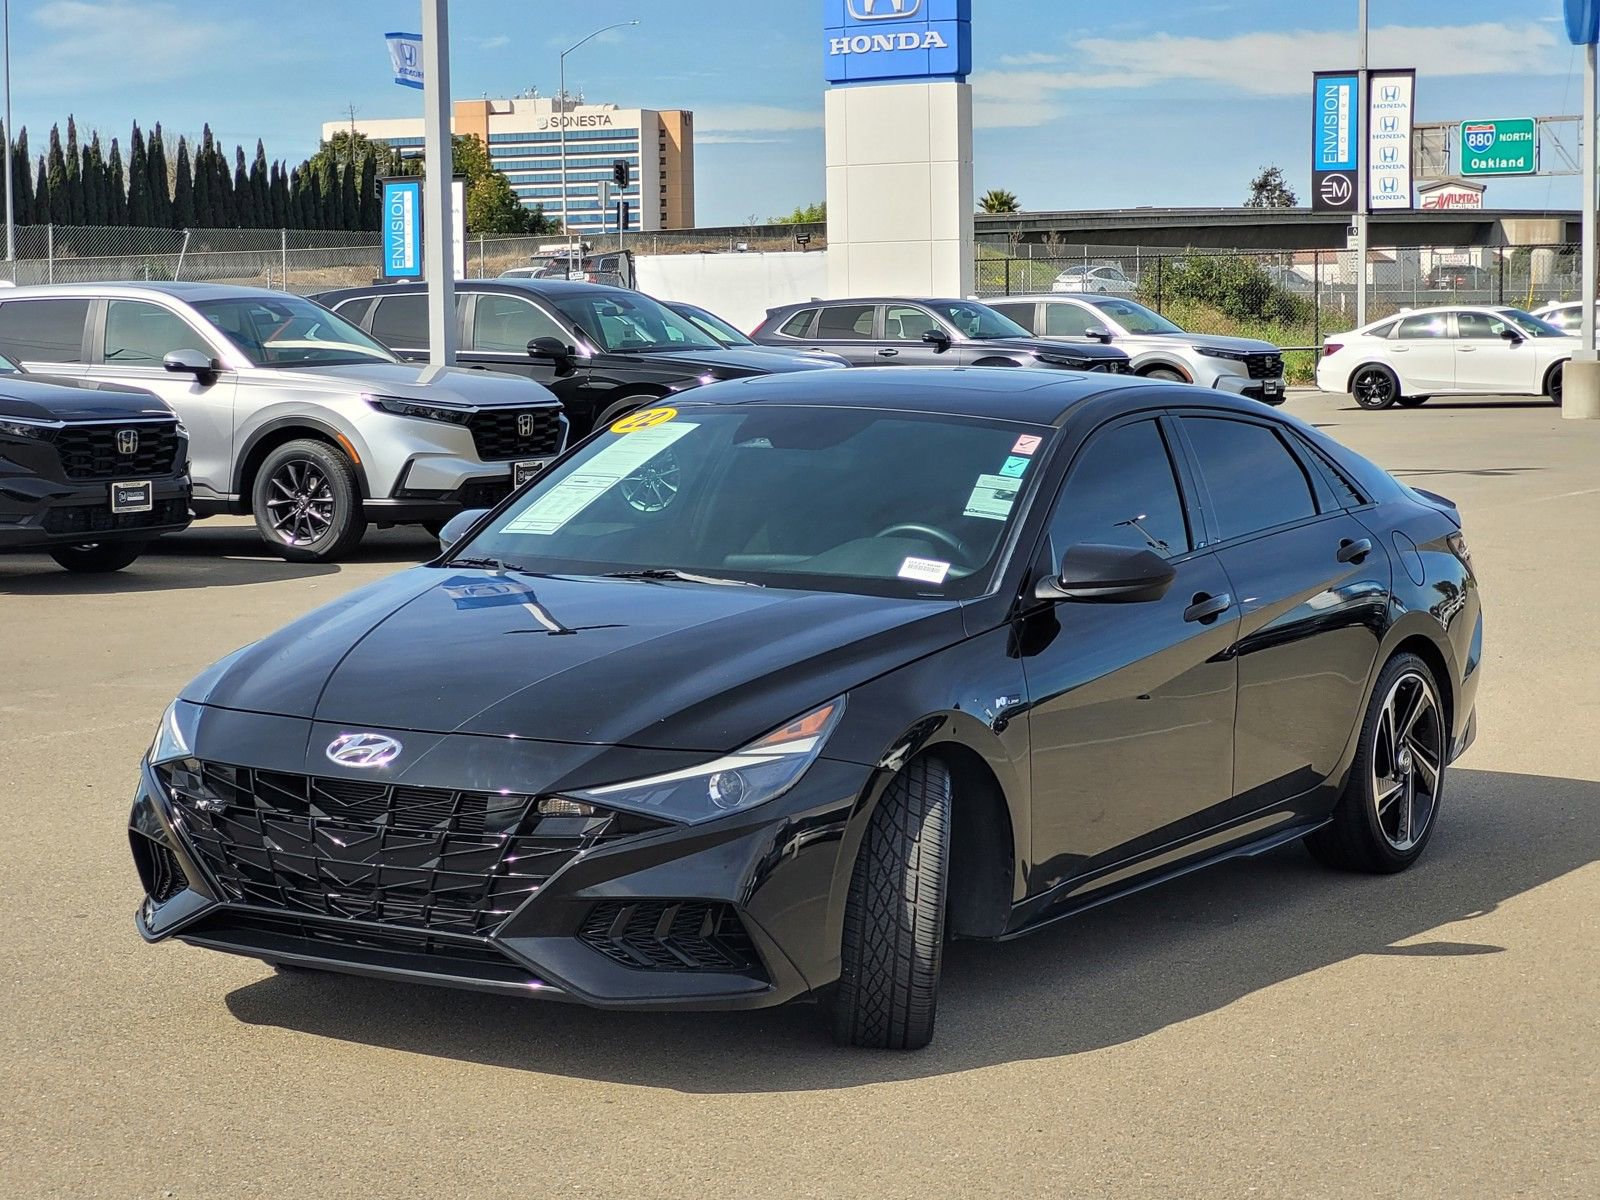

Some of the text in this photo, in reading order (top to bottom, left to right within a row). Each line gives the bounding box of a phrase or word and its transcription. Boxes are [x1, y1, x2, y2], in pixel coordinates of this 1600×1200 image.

[829, 31, 948, 55] HONDA
[550, 115, 613, 128] SONESTA
[1323, 85, 1338, 163] ENVISION
[1469, 132, 1532, 146] 880 NORTH
[1471, 157, 1524, 169] Oakland
[391, 191, 404, 268] ENVISION
